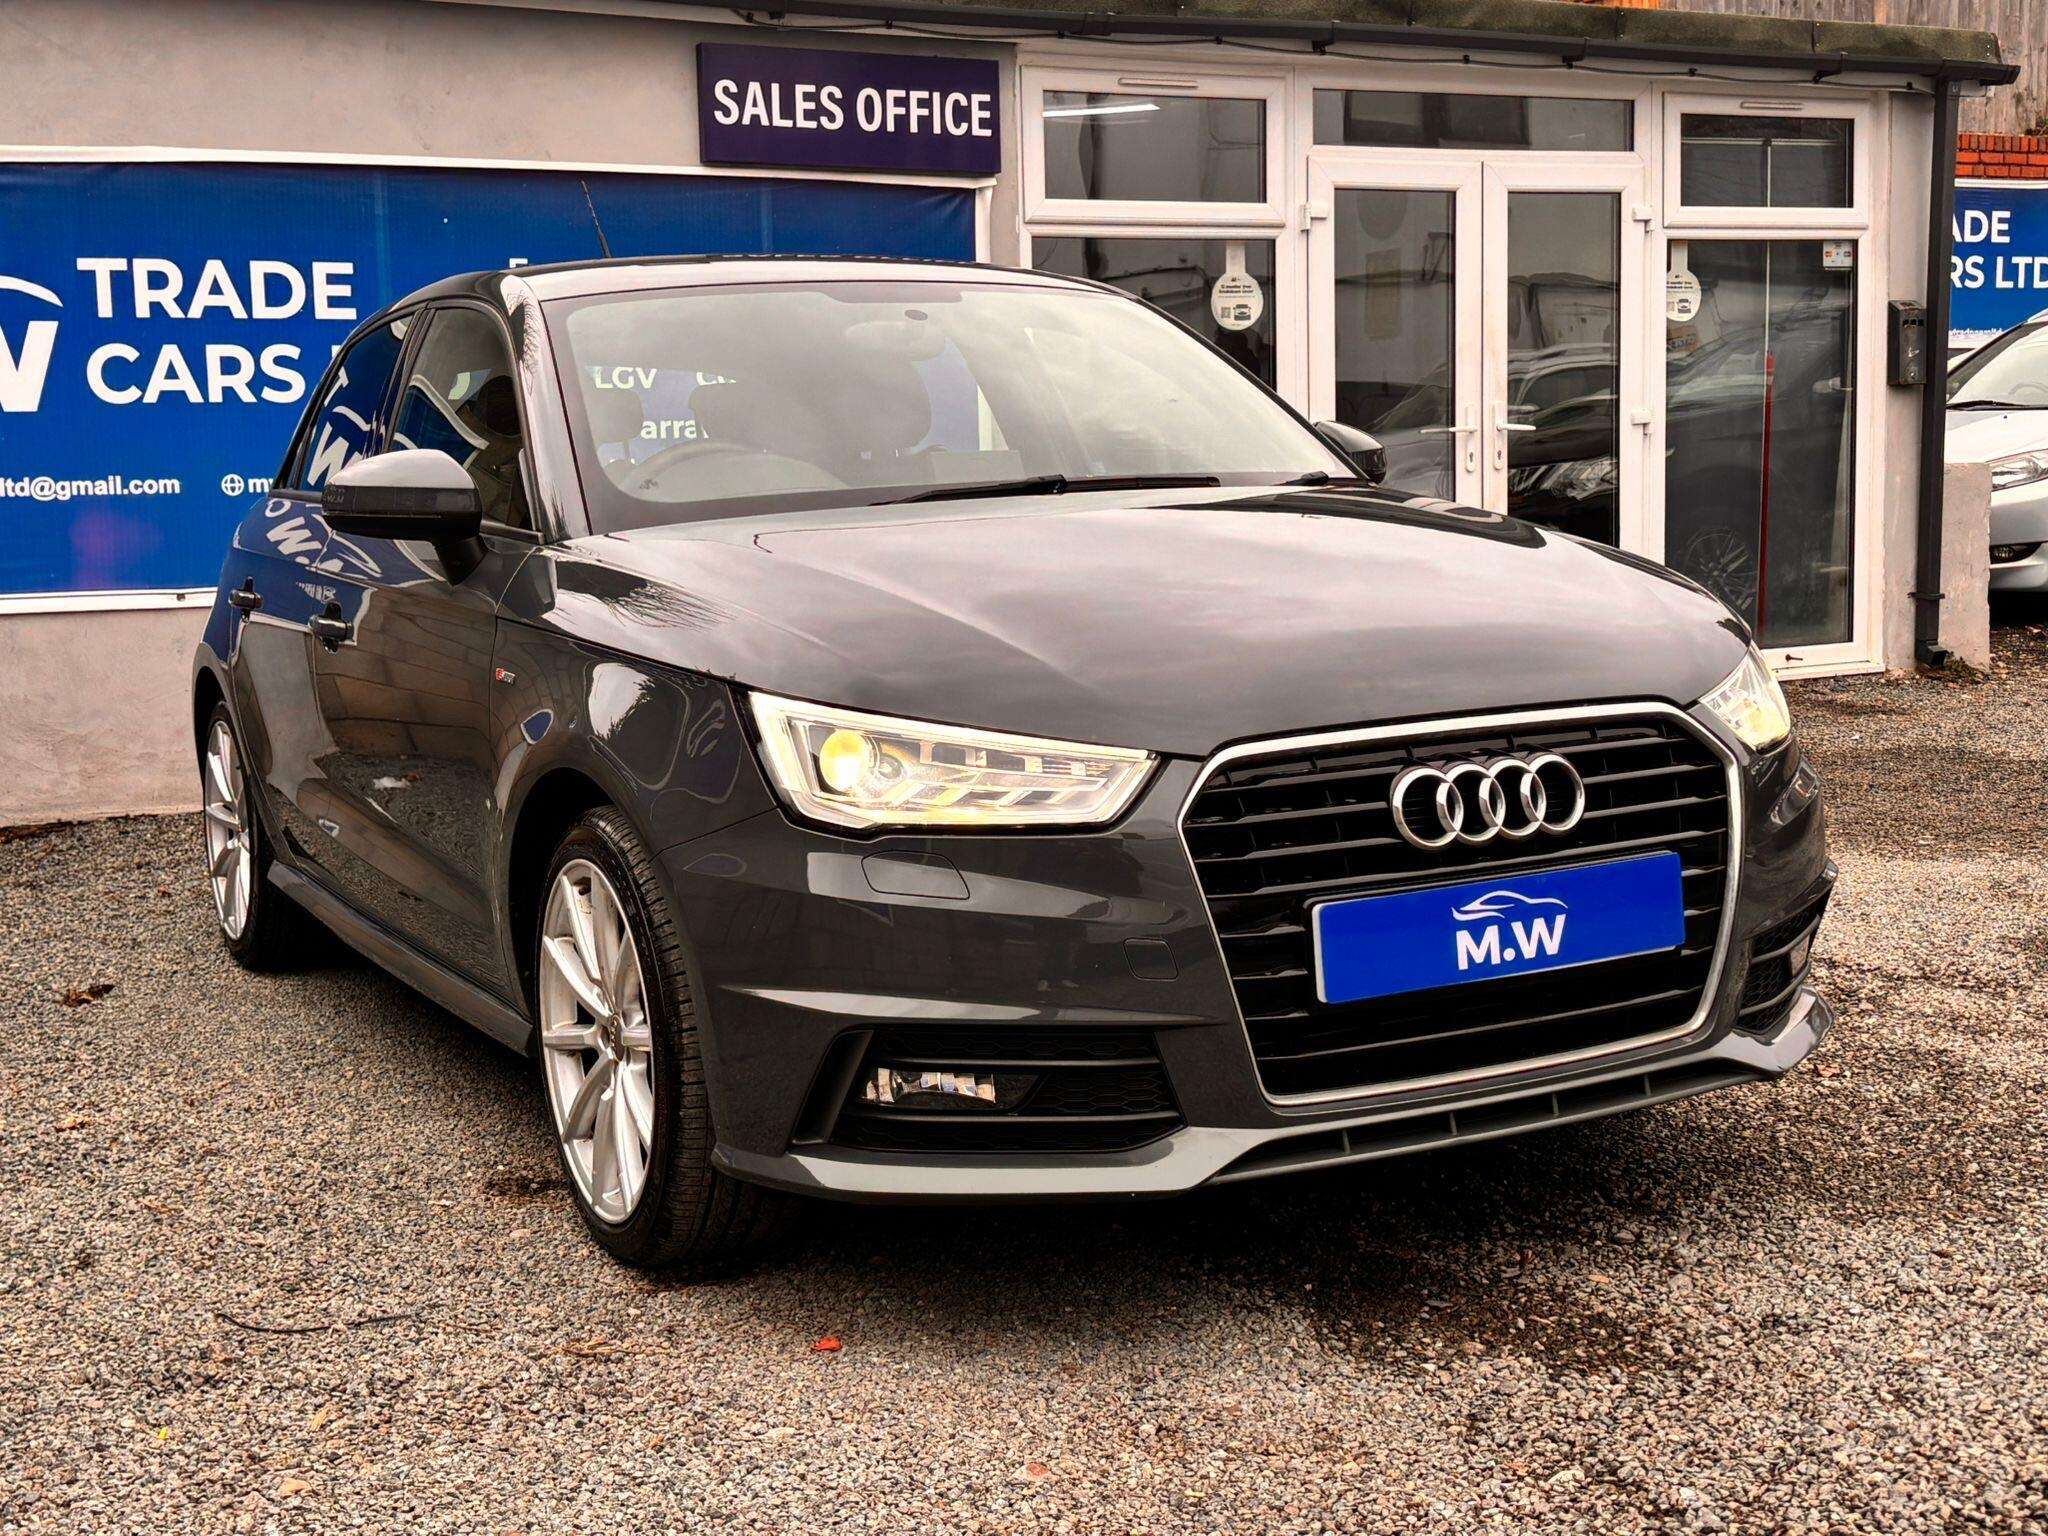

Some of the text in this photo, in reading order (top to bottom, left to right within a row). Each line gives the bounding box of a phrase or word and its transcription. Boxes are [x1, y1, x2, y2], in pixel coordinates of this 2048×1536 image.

[714, 79, 992, 137] SALES OFFICE
[76, 257, 357, 320] TRADE
[86, 342, 307, 405] CARS
[594, 366, 657, 389] LGV
[0, 475, 181, 501] ltd@gmail.com
[1456, 914, 1567, 970] M.W
